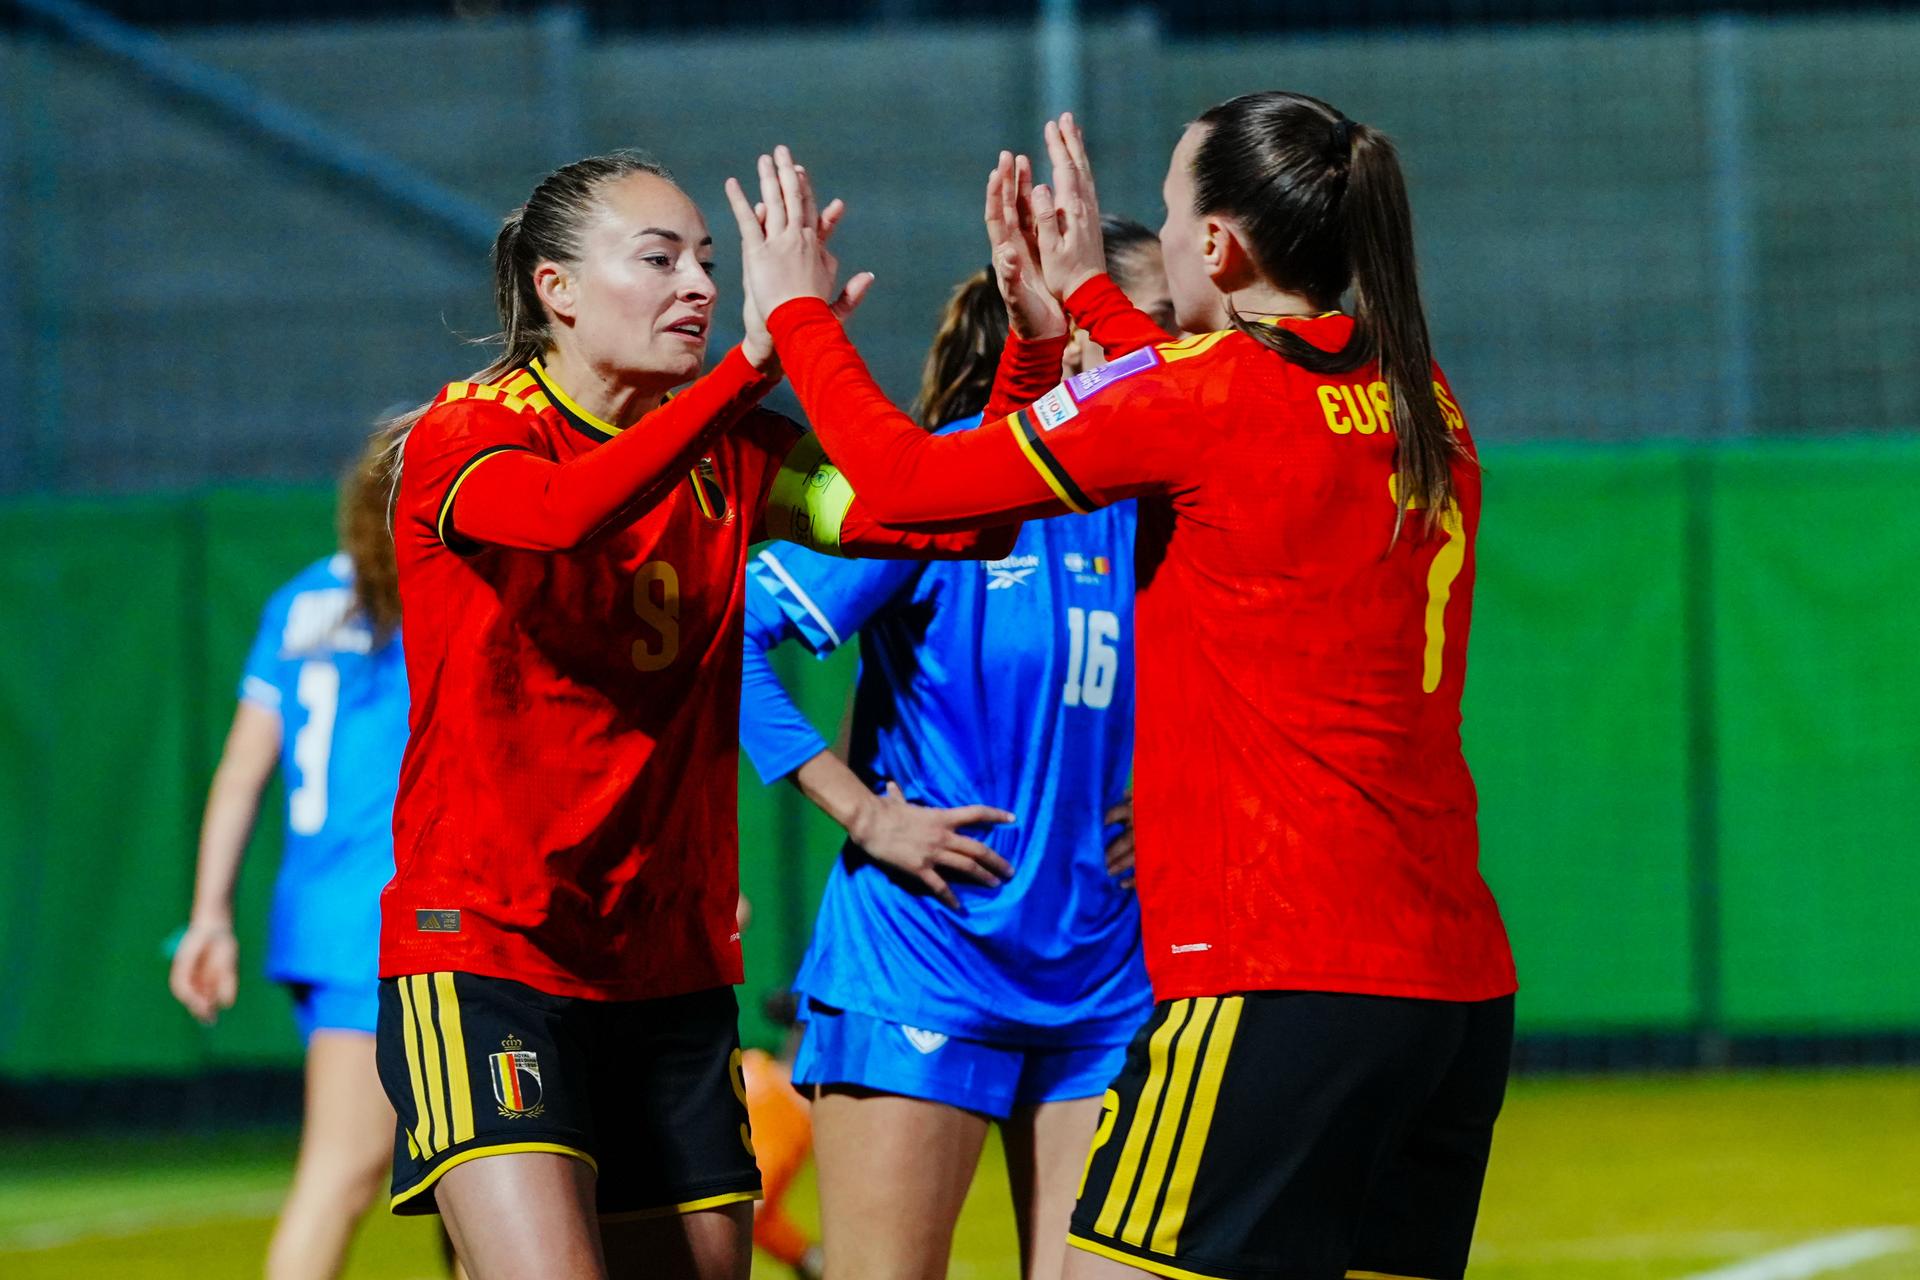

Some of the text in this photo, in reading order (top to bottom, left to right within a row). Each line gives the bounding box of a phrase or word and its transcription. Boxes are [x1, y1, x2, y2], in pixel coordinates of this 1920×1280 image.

[1046, 392, 1066, 422] TION
[1316, 380, 1464, 435] EURS
[631, 560, 680, 672] 9
[1063, 606, 1120, 709] 16
[289, 661, 341, 836] 3
